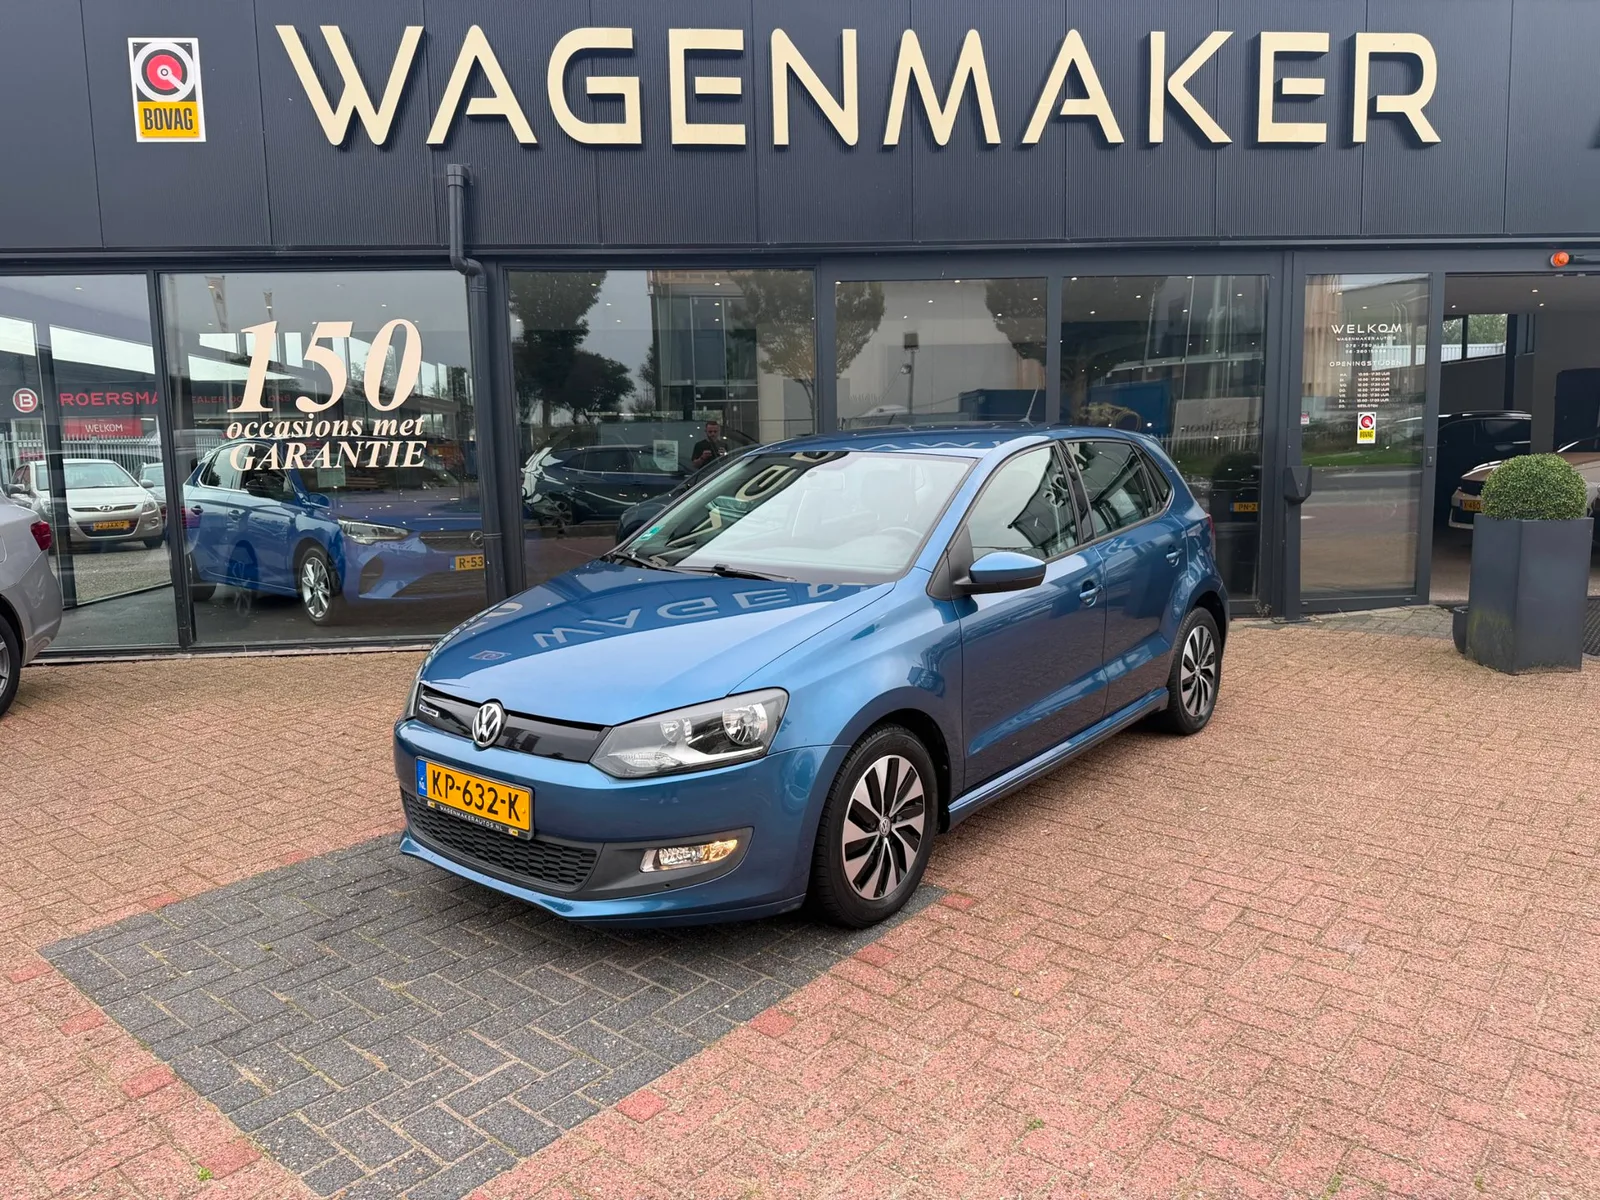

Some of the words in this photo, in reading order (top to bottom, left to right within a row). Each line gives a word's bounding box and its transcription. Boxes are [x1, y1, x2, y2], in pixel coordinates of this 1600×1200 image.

[275, 24, 1441, 147] WAGENMAKER
[143, 107, 194, 130] BOVAG
[1330, 323, 1403, 334] WELKOM
[227, 318, 422, 413] 150
[84, 424, 124, 433] WELKOM
[227, 413, 363, 439] occasions
[372, 415, 425, 437] met
[230, 440, 427, 471] GARANTIE
[432, 769, 521, 822] KP-632-K
